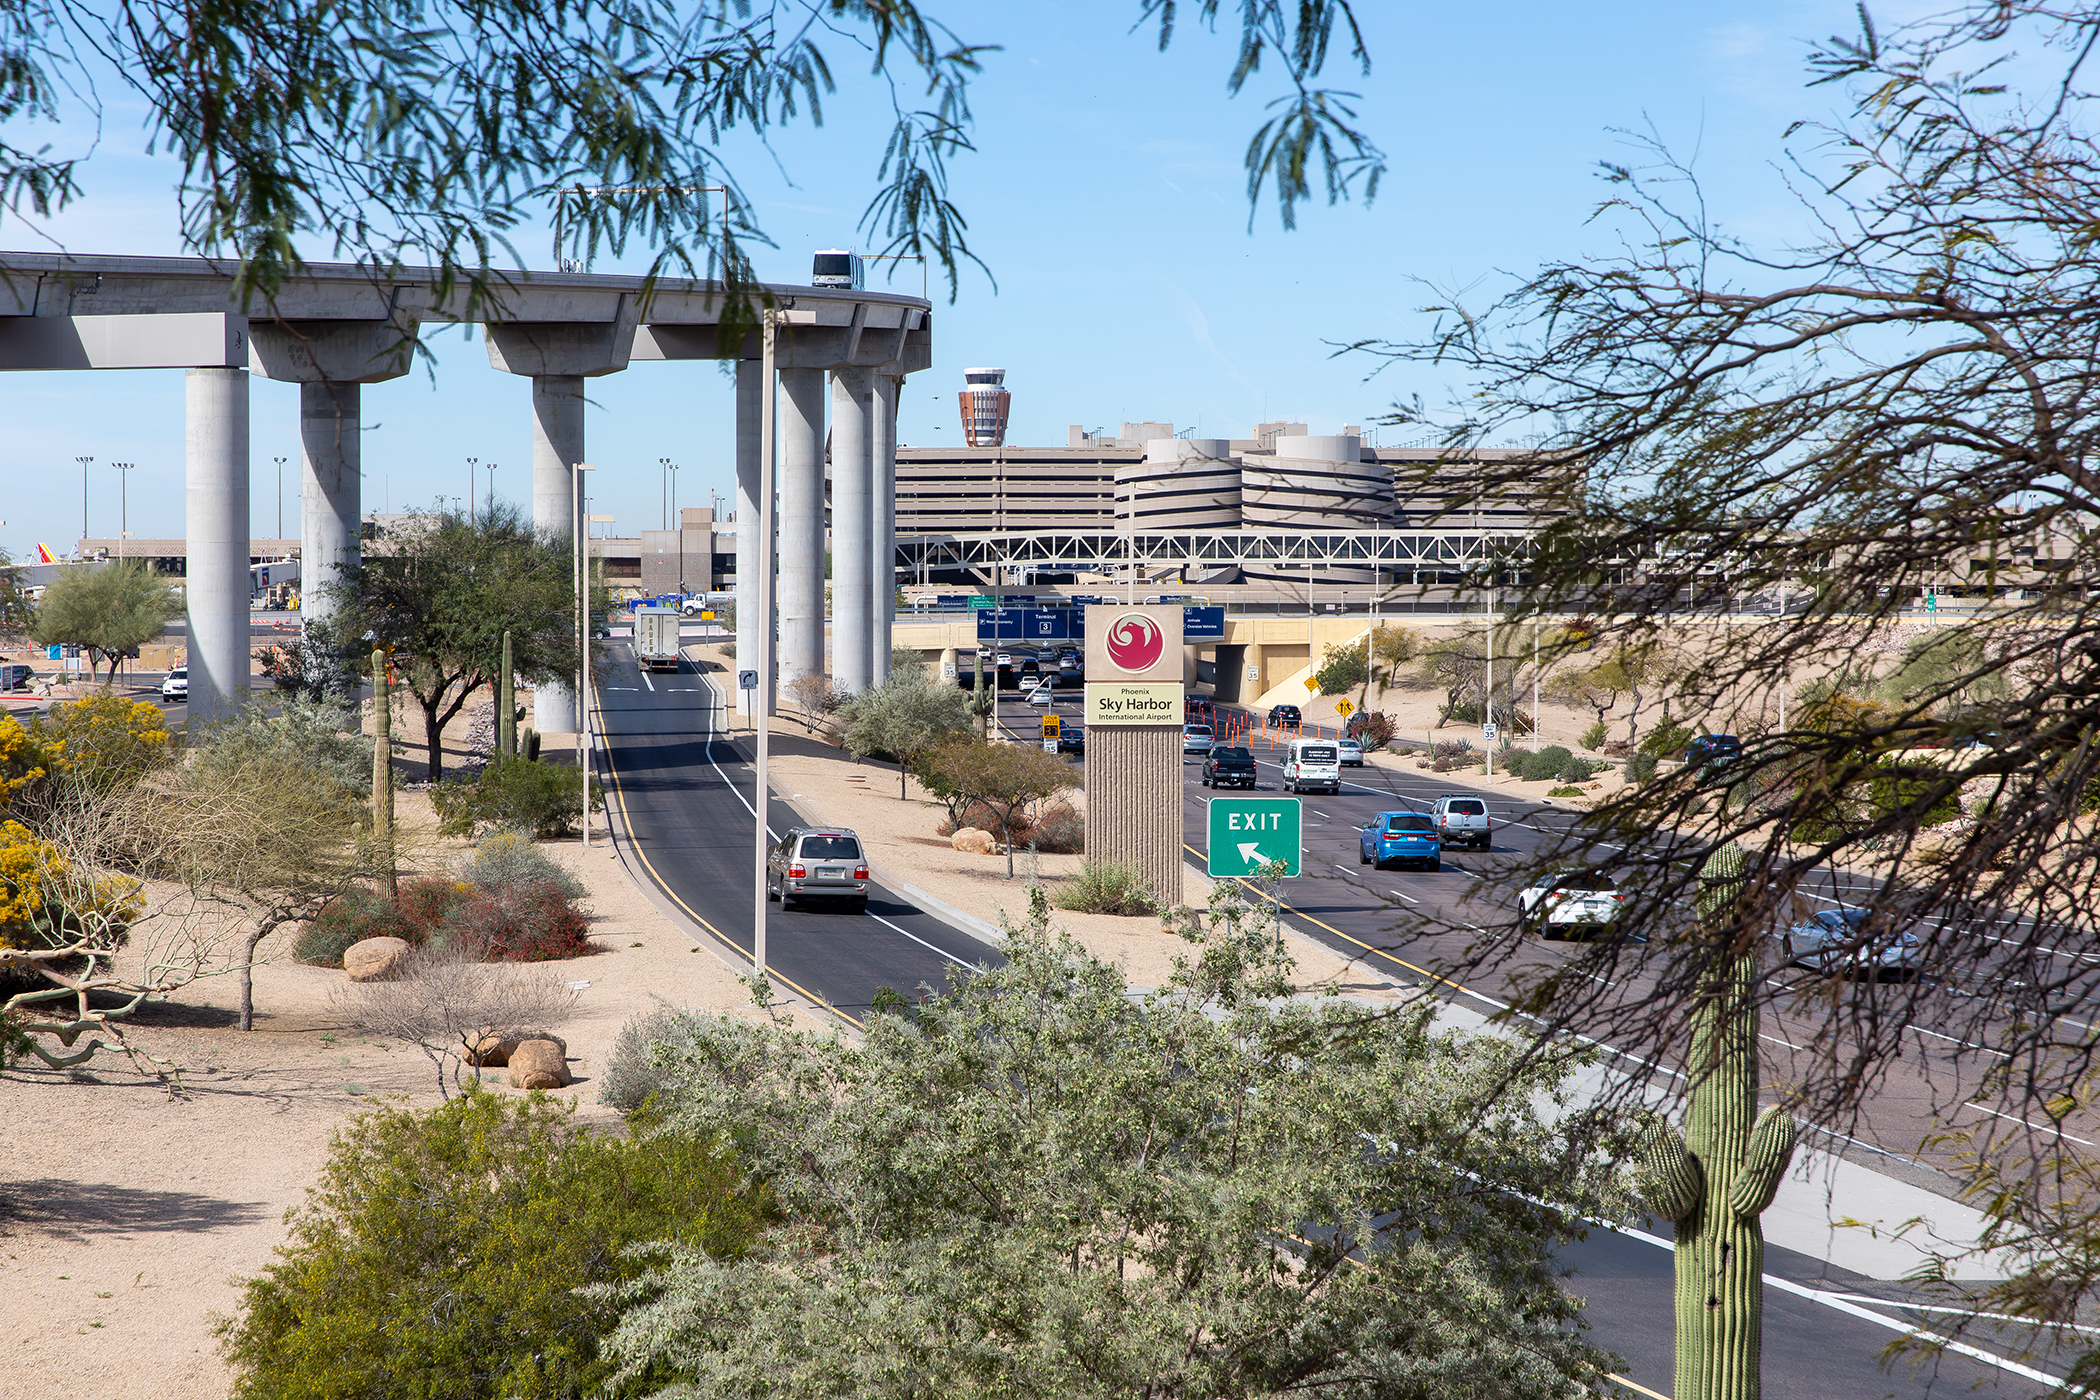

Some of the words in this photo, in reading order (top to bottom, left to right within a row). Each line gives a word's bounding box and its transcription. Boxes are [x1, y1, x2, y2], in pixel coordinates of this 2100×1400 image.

[1099, 698, 1123, 713] Sky
[1126, 698, 1172, 710] Harbor
[1146, 713, 1172, 721] Airport
[1046, 726, 1058, 736] 37
[1228, 813, 1282, 830] EXIT
